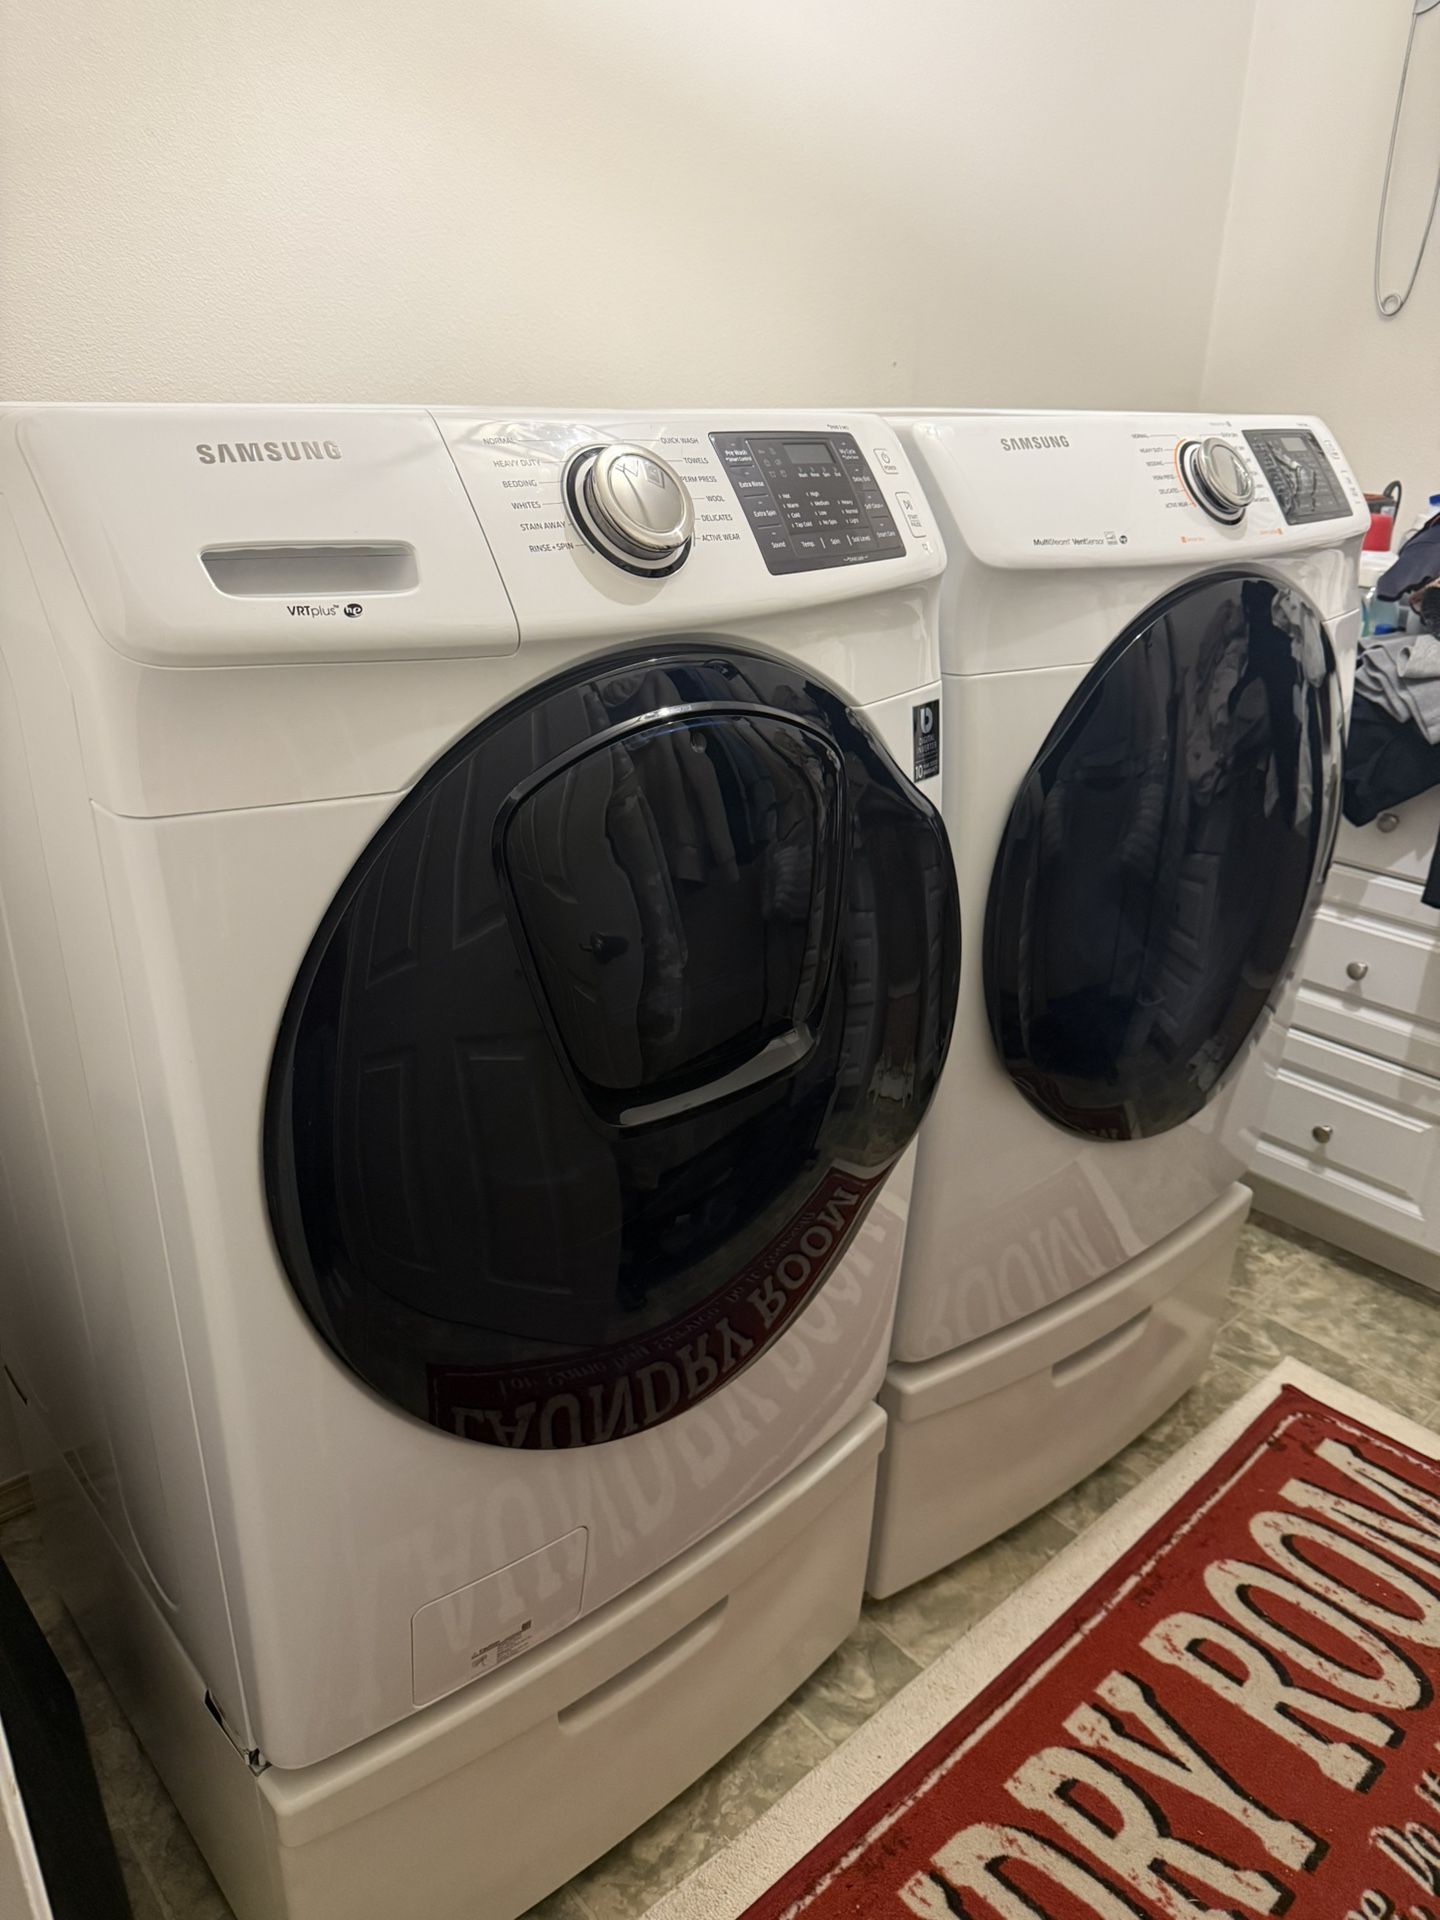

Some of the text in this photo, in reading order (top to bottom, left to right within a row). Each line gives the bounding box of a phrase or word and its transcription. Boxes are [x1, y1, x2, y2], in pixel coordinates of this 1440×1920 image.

[1000, 435, 1070, 452] SAMSUNG
[196, 440, 343, 465] SAMSUNG
[493, 459, 541, 468] HEAVY DUTY
[502, 480, 538, 488] BEDDING
[511, 501, 541, 510] WHITES
[520, 521, 566, 531] STAIN AWAY
[702, 533, 740, 542] ACTIVE WEAR
[529, 544, 552, 552] RINSE
[556, 542, 574, 551] SPIN
